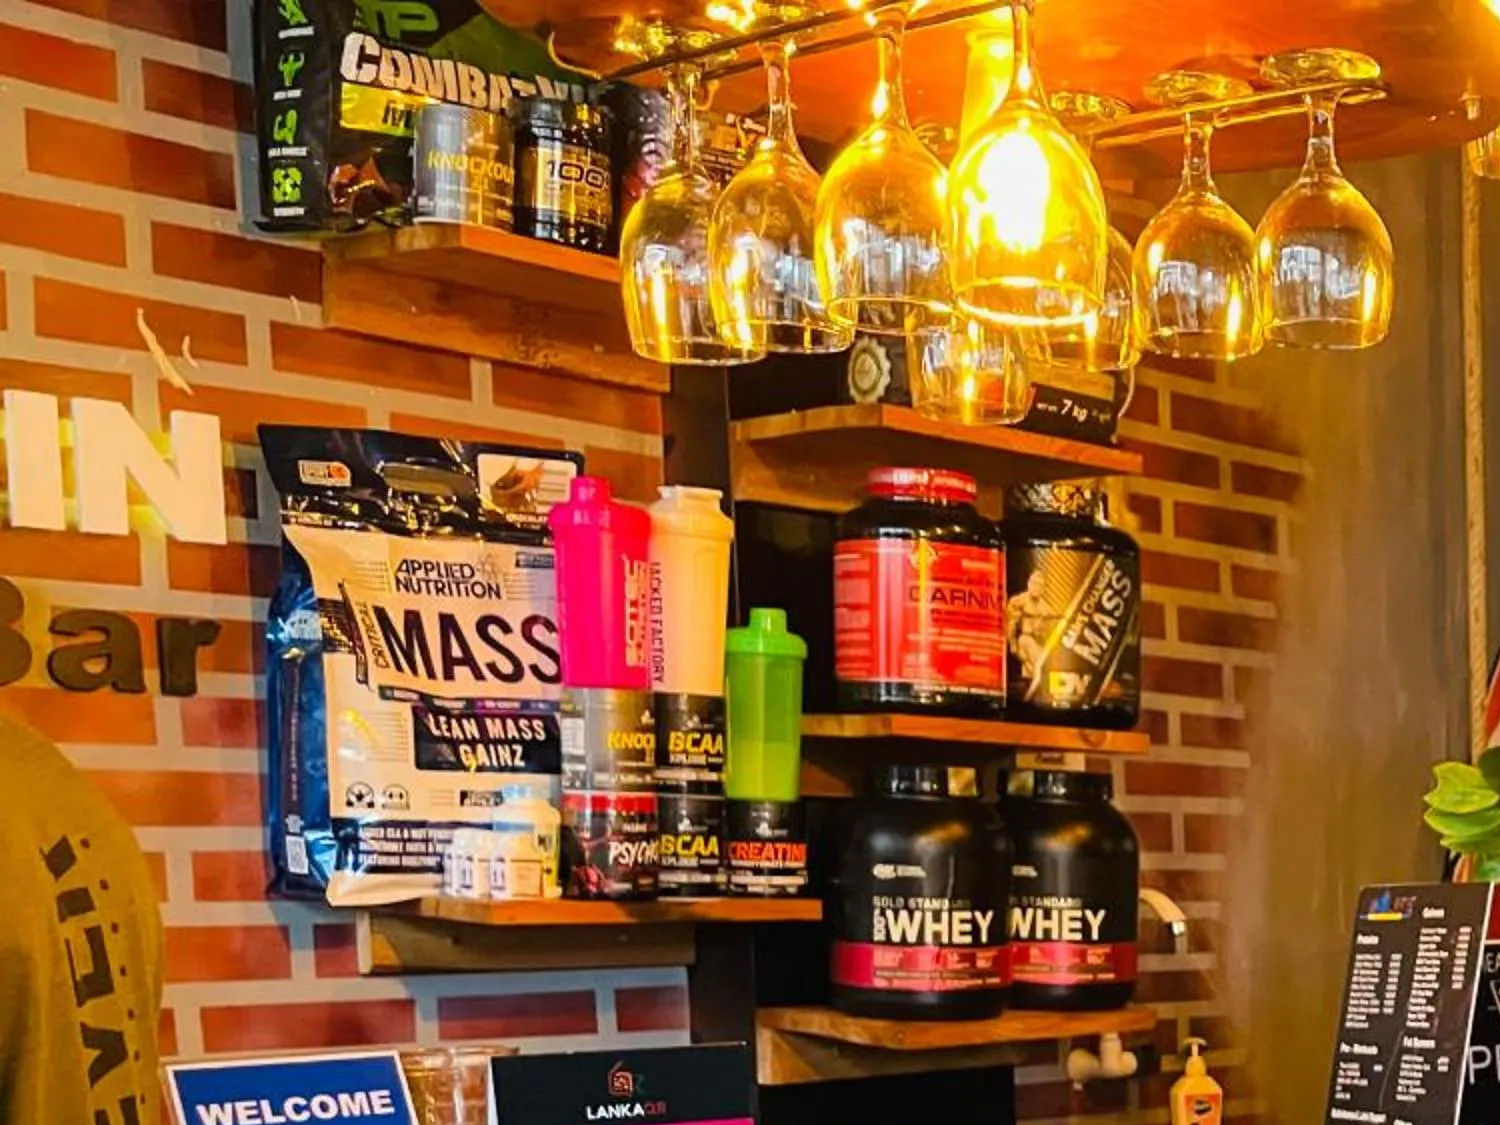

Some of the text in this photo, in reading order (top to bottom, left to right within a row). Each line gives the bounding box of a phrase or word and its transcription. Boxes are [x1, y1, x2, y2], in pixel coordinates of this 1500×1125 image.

[3, 388, 228, 545] IN
[396, 558, 476, 580] APPLIED
[395, 577, 502, 601] NUTRITION
[1073, 569, 1132, 666] MASS
[371, 603, 562, 686] MASS
[649, 618, 666, 684] FACTORY
[428, 712, 547, 743] LEAN MASS
[669, 730, 724, 754] BCAA
[458, 743, 526, 769] GAINZ
[660, 833, 719, 858] BCAA
[885, 908, 994, 945] WHEY
